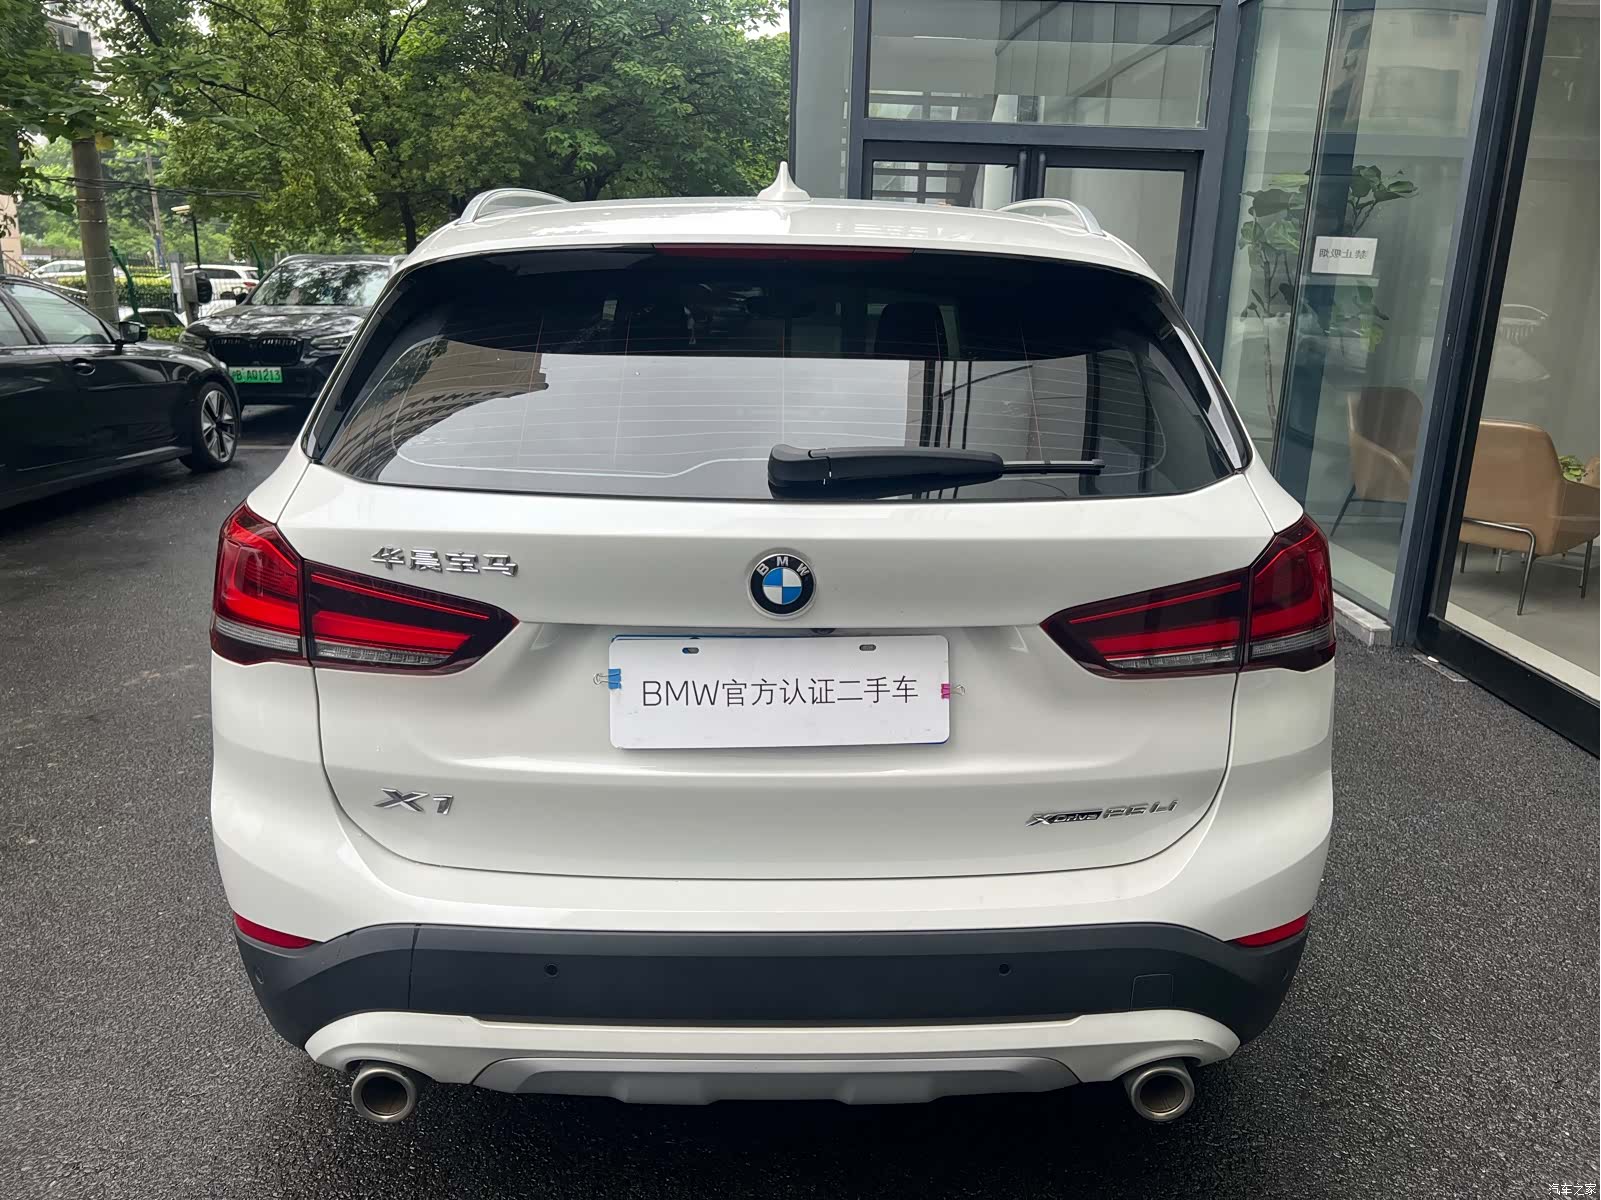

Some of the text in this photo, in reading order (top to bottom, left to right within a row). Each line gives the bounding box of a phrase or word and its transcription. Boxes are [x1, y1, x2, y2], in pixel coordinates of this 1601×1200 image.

[370, 546, 519, 577] 华晨宝马
[756, 556, 810, 577] BMW
[641, 675, 919, 707] BMW官方认证二手车
[373, 787, 454, 815] X1
